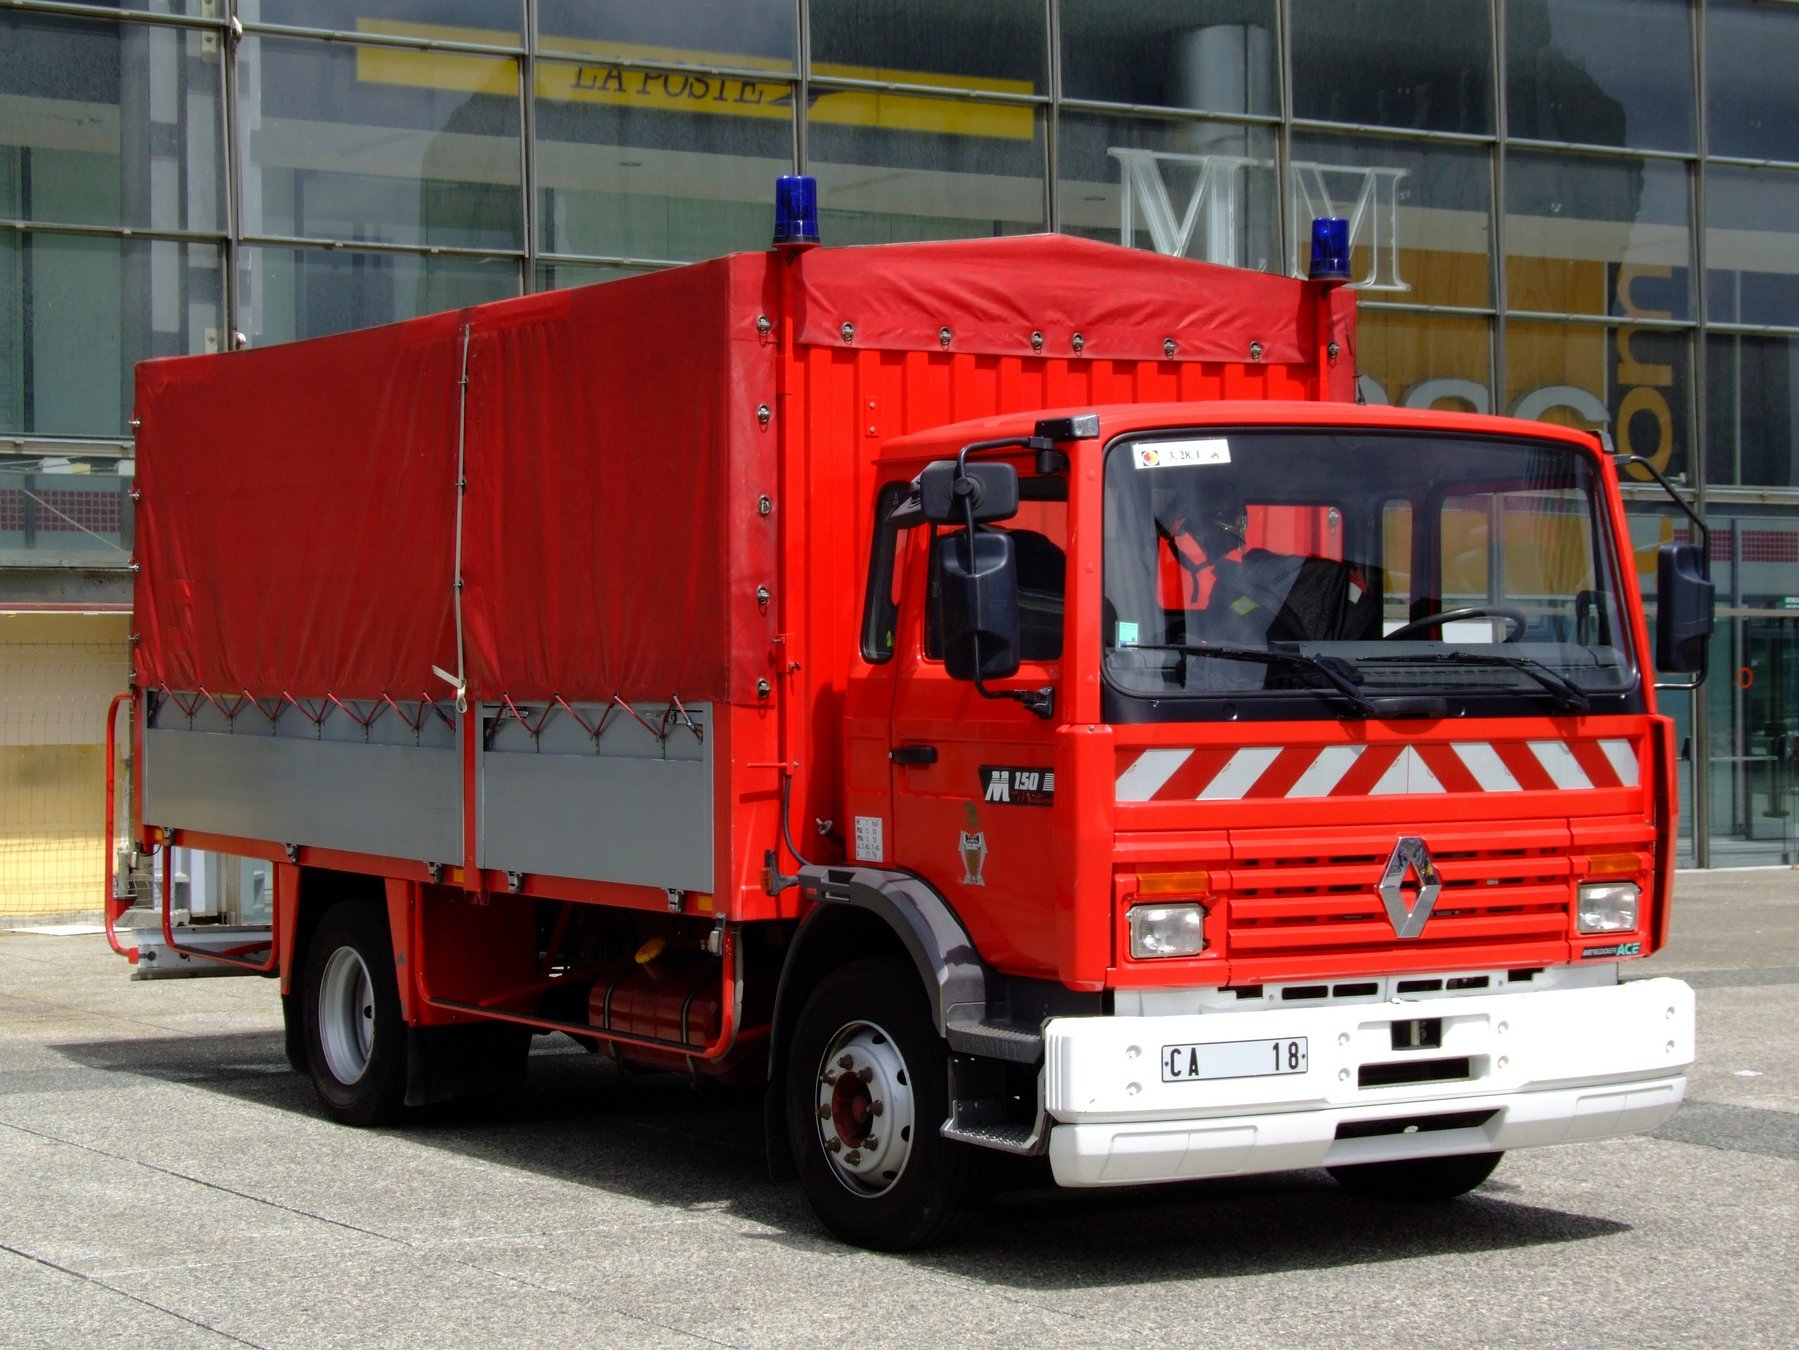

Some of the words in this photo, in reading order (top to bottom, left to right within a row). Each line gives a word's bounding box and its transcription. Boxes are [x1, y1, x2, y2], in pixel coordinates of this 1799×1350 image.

[570, 56, 627, 93] LA
[636, 57, 764, 105] POSTE
[984, 770, 1011, 802] M
[1014, 771, 1040, 791] 150
[1615, 942, 1641, 957] ACE
[1170, 1047, 1200, 1077] CA
[1272, 1041, 1300, 1071] 18
